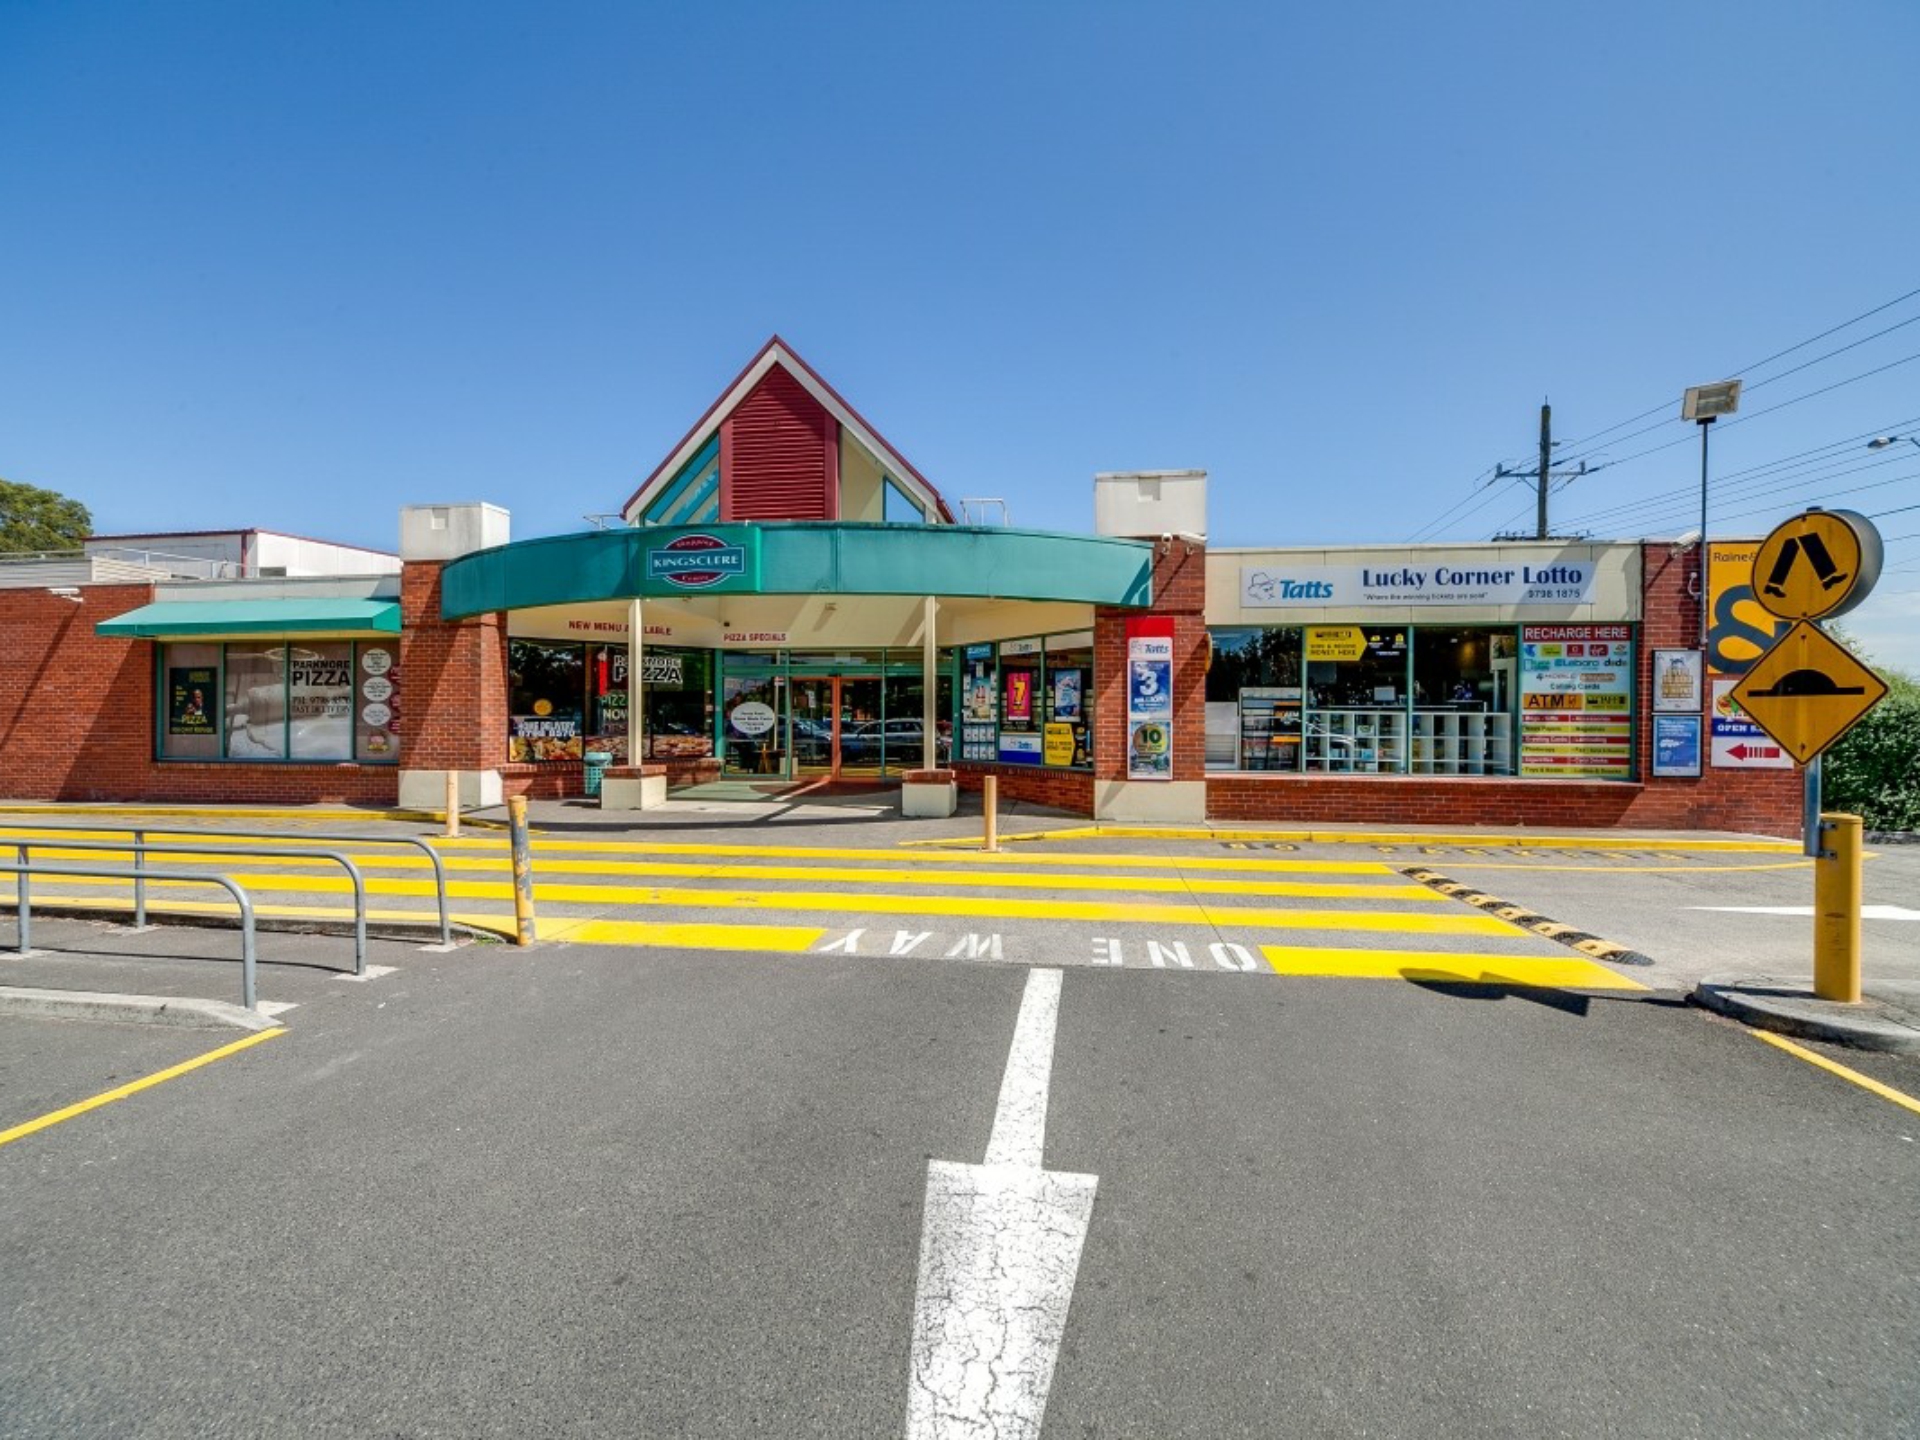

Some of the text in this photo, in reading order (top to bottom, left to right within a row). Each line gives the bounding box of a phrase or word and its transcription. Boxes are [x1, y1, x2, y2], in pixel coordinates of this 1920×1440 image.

[653, 555, 739, 568] KINGSCLERE
[1362, 566, 1582, 590] Lucky Corner Lotto
[1280, 579, 1333, 599] Tatts
[1556, 588, 1580, 598] 1875
[569, 620, 590, 630] NEW
[594, 622, 622, 632] MENU
[724, 632, 786, 642] PIZZA SPECIALS
[1525, 627, 1627, 639] RECHARGE HERE
[1145, 644, 1169, 654] Tatts
[292, 660, 350, 669] PARKMORE
[292, 671, 351, 686] PIZZA
[1528, 694, 1564, 707] ATM
[1717, 724, 1747, 732] OPEN
[819, 927, 1260, 973] ONE WAY
